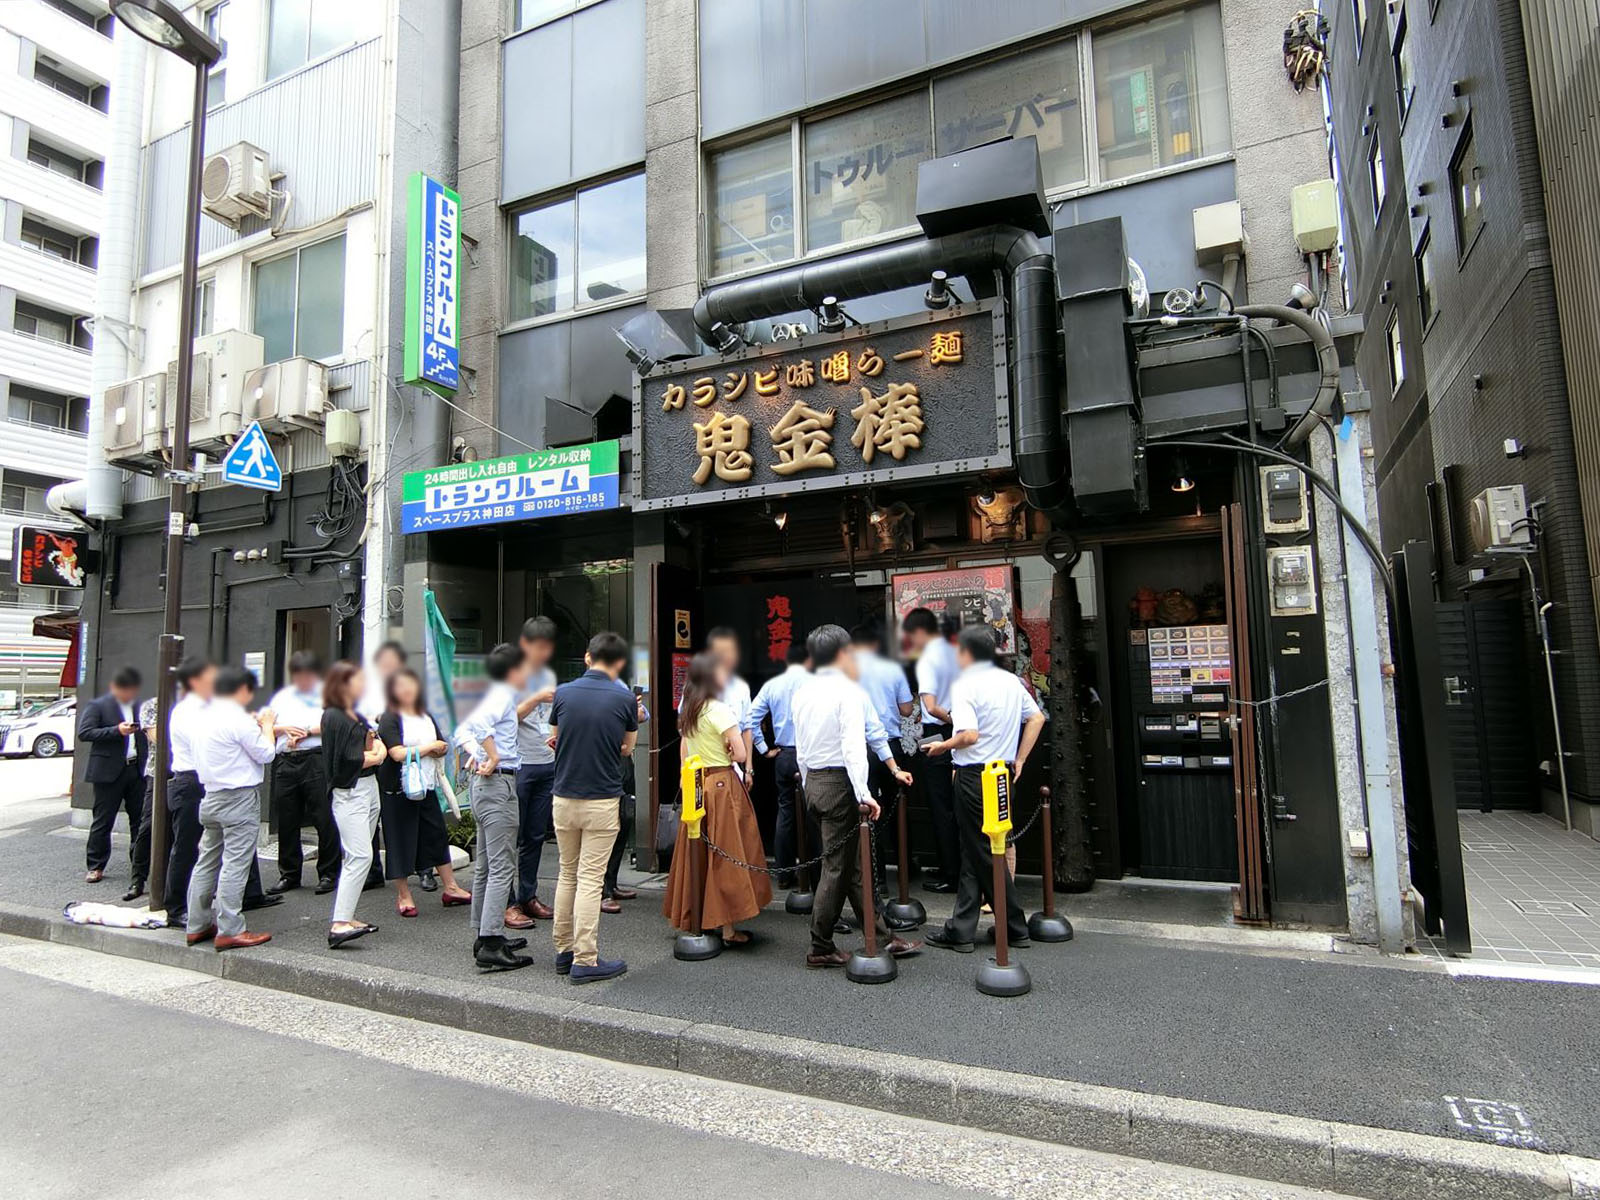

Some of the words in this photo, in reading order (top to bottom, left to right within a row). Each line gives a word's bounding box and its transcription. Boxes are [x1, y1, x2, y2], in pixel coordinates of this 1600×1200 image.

[437, 199, 454, 340] トランクルーム
[426, 341, 447, 361] 4F
[691, 381, 925, 486] 鬼金棒
[425, 461, 517, 485] 24時間出し入れ自由
[527, 447, 592, 469] レンタル収納
[433, 468, 580, 509] トランクルーム
[413, 504, 516, 528] スペースプラス神田店
[536, 492, 605, 510] 0120-816-185
